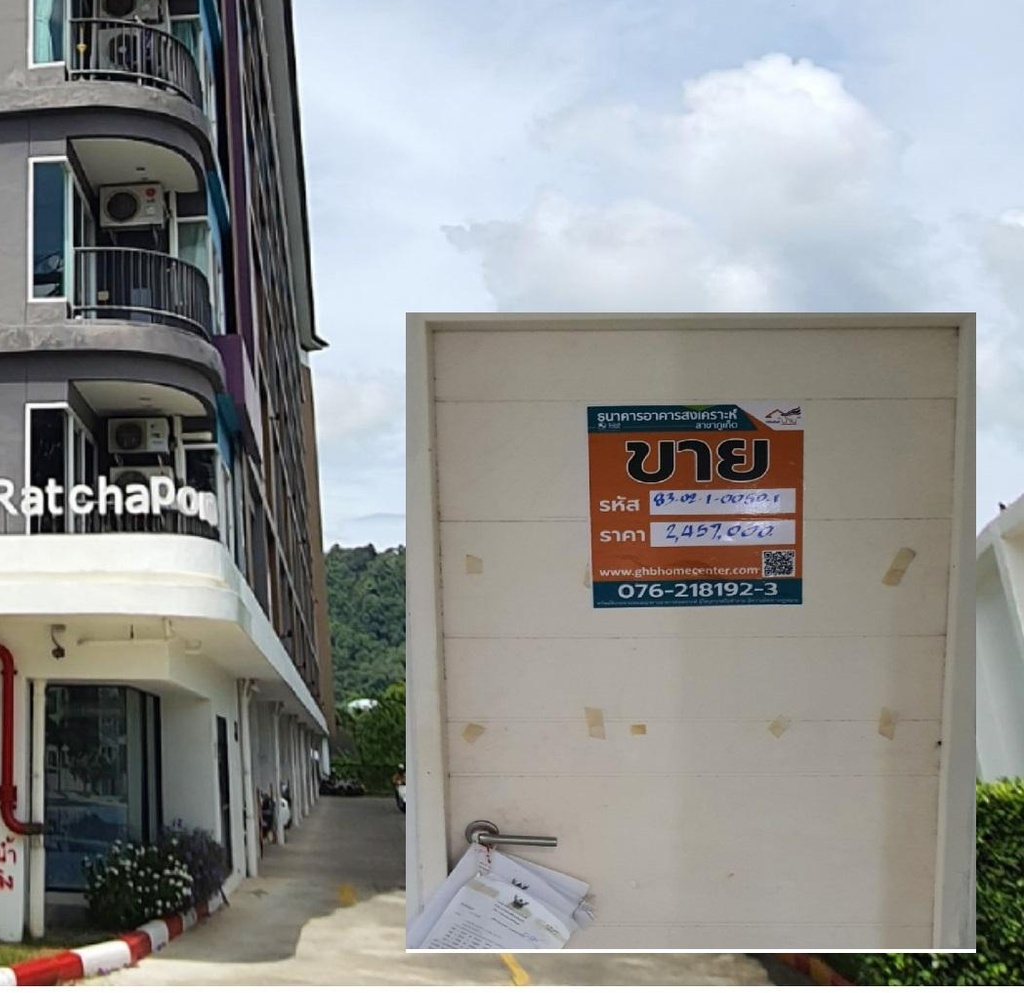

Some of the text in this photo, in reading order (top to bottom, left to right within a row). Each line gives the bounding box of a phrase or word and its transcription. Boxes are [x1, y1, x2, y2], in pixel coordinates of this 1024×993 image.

[596, 408, 738, 423] ธนาคารอาคารสงเคราะห์
[625, 437, 771, 485] ขาย
[599, 496, 641, 513] รหัส
[599, 529, 646, 543] ราคา
[599, 566, 759, 578] www.ghbhomecenter.com
[618, 582, 779, 599] 076-218192-3
